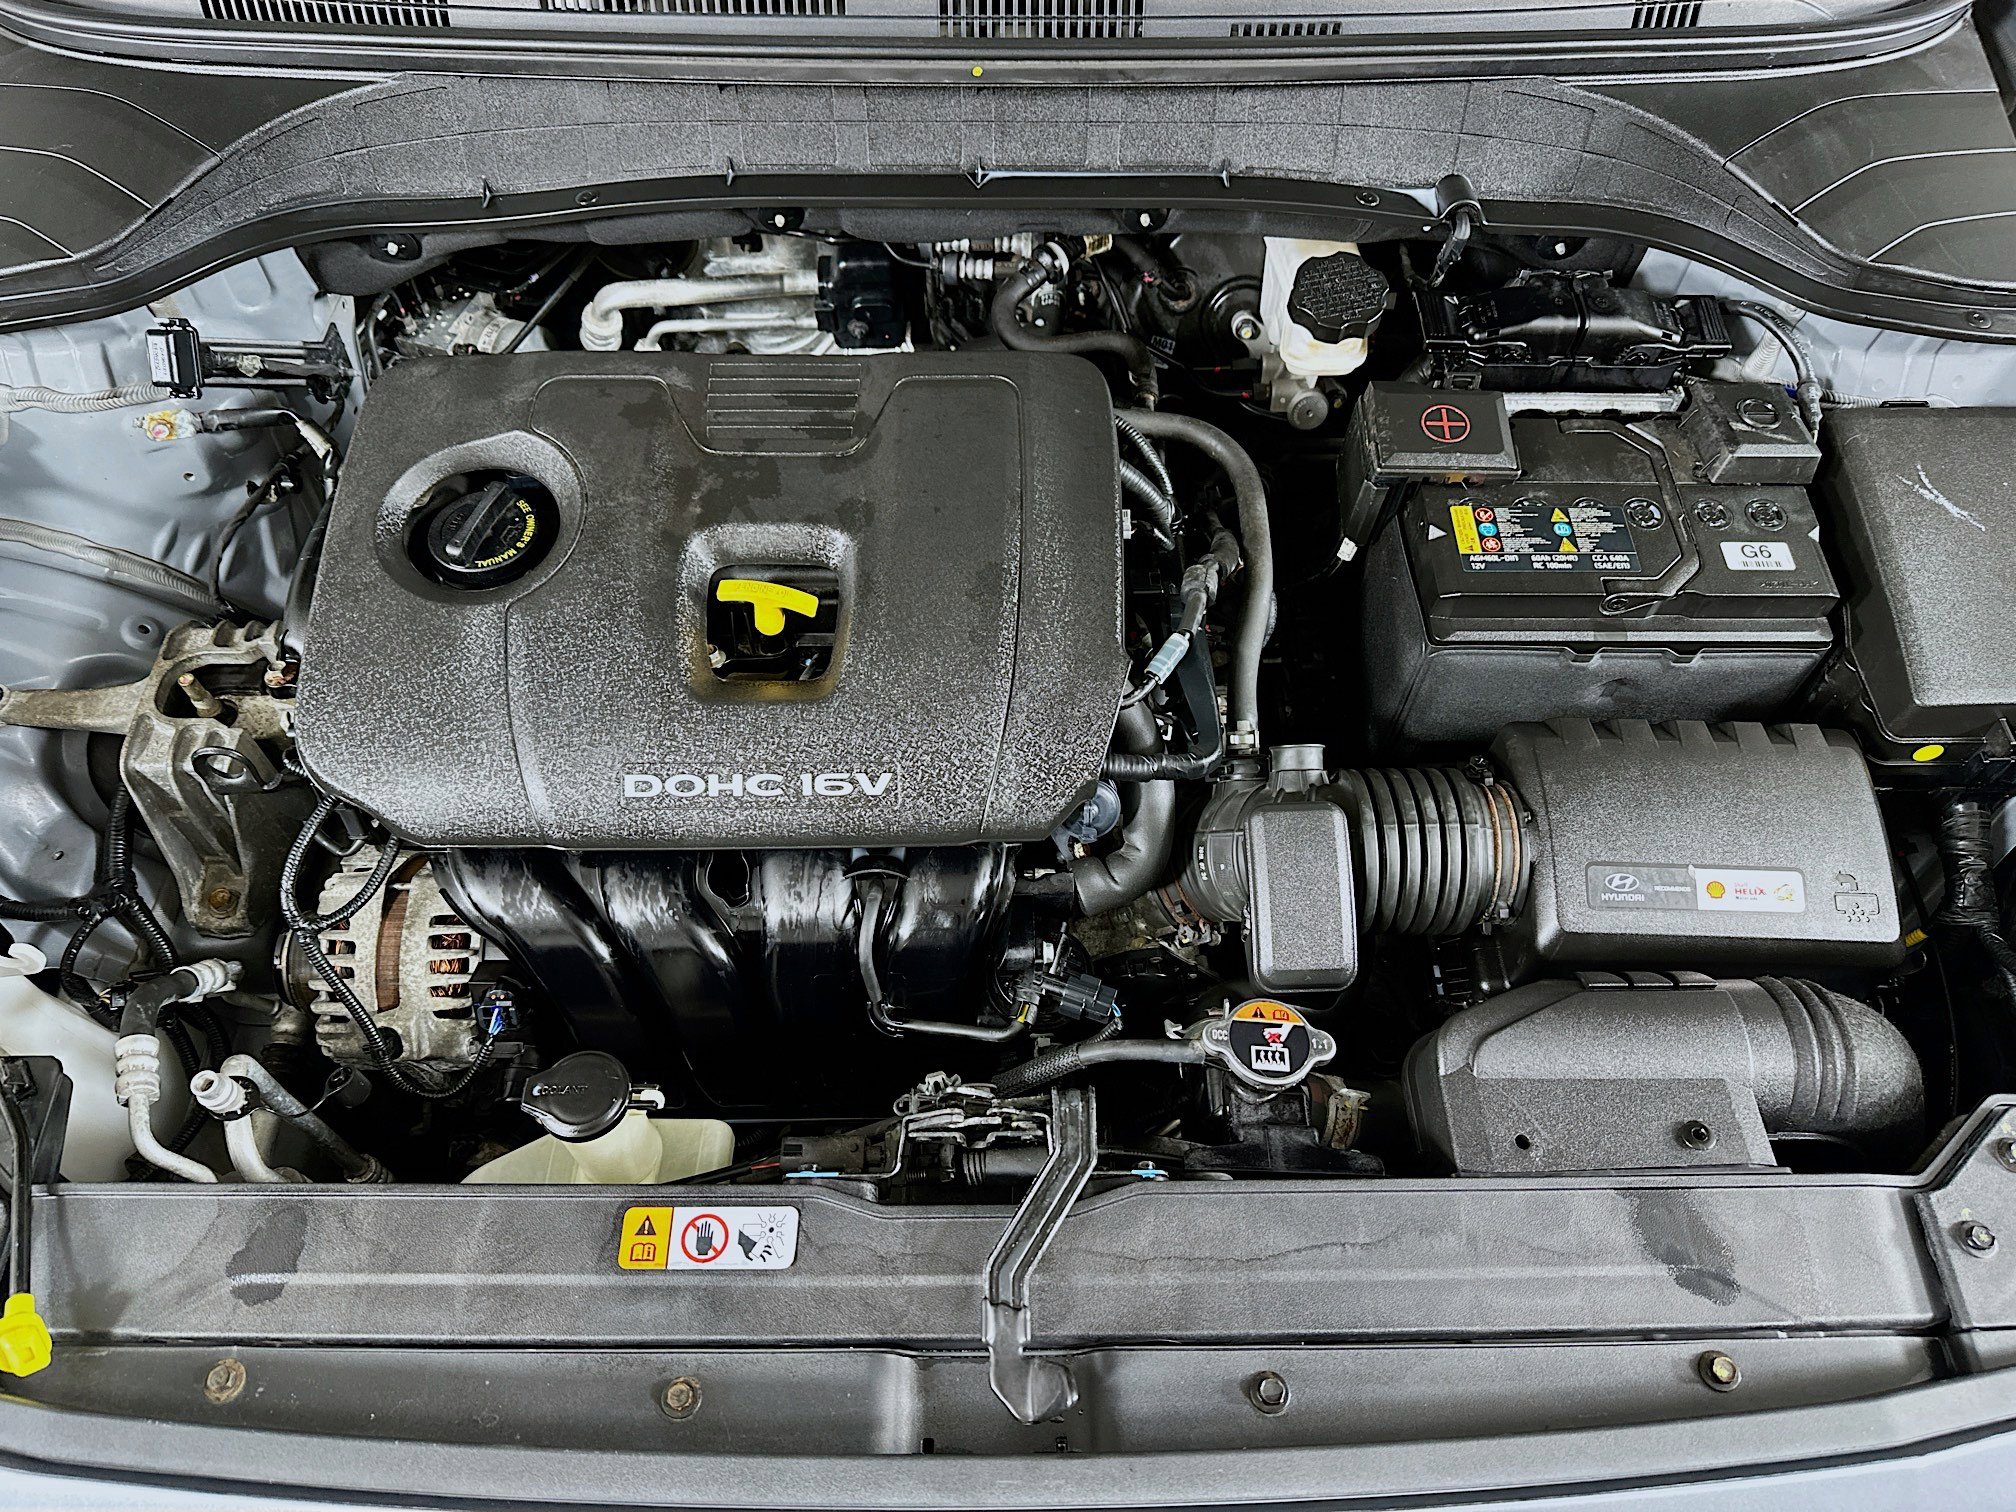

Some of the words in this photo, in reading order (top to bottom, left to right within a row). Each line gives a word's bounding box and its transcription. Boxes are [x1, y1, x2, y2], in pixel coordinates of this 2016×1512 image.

[516, 499, 531, 514] SEE
[517, 513, 537, 549] OWNER'S
[475, 547, 518, 568] MANUAL
[1741, 544, 1772, 559] G6
[624, 774, 784, 798] DOHC
[801, 773, 893, 796] 16V
[1601, 893, 1645, 902] HYUNDAI
[1734, 887, 1767, 896] HELIX
[1311, 1038, 1328, 1050] 1.1
